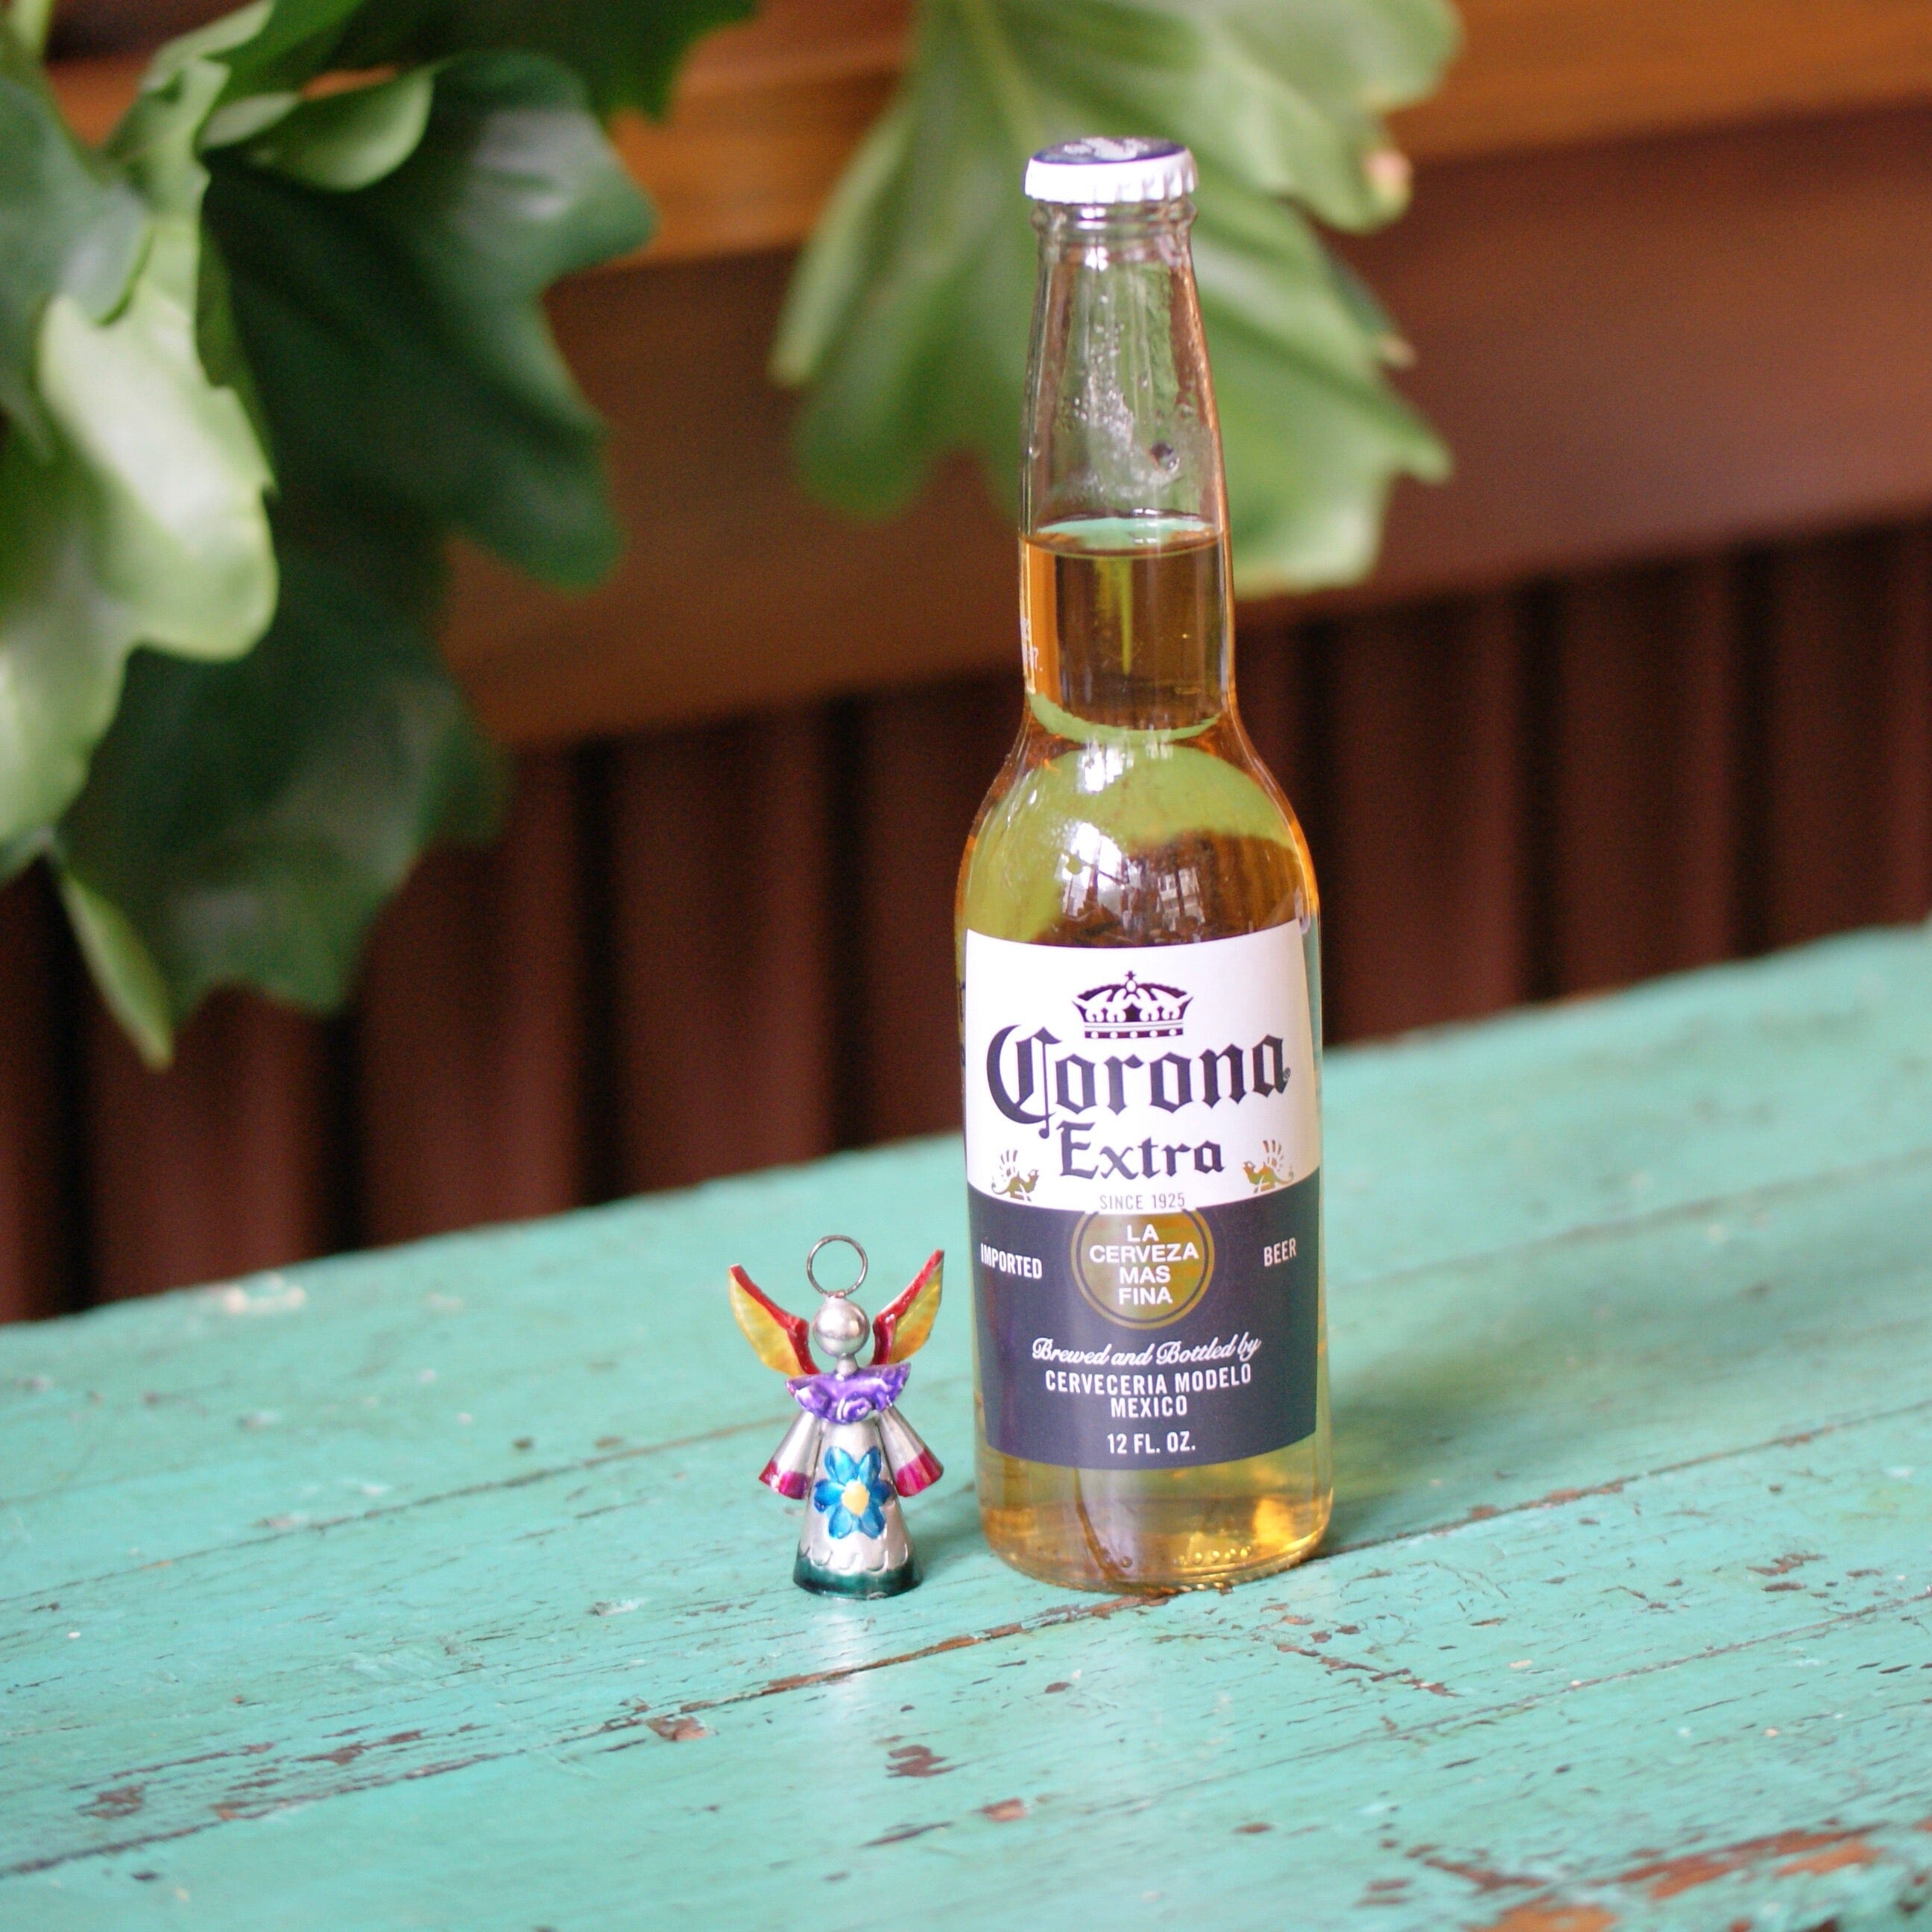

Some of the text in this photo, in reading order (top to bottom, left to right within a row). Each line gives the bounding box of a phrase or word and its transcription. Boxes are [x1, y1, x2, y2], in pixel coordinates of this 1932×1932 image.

[986, 1024, 1288, 1139] Corona
[1055, 1120, 1225, 1180] Extra
[1099, 1193, 1186, 1210] SINCE 1925
[1126, 1223, 1159, 1242] LA
[980, 1243, 1043, 1279] IMPORTED
[1089, 1242, 1199, 1263] CERVEZA
[1263, 1237, 1297, 1266] BEER
[1119, 1266, 1171, 1284] MAS
[1119, 1287, 1172, 1305] FINA
[1032, 1332, 1262, 1366] Brewed and Bottled by
[1045, 1363, 1251, 1395] CERVECERIA MODELO
[1110, 1395, 1188, 1418] MEXICO
[1107, 1430, 1196, 1454] 12 FL. OZ.
